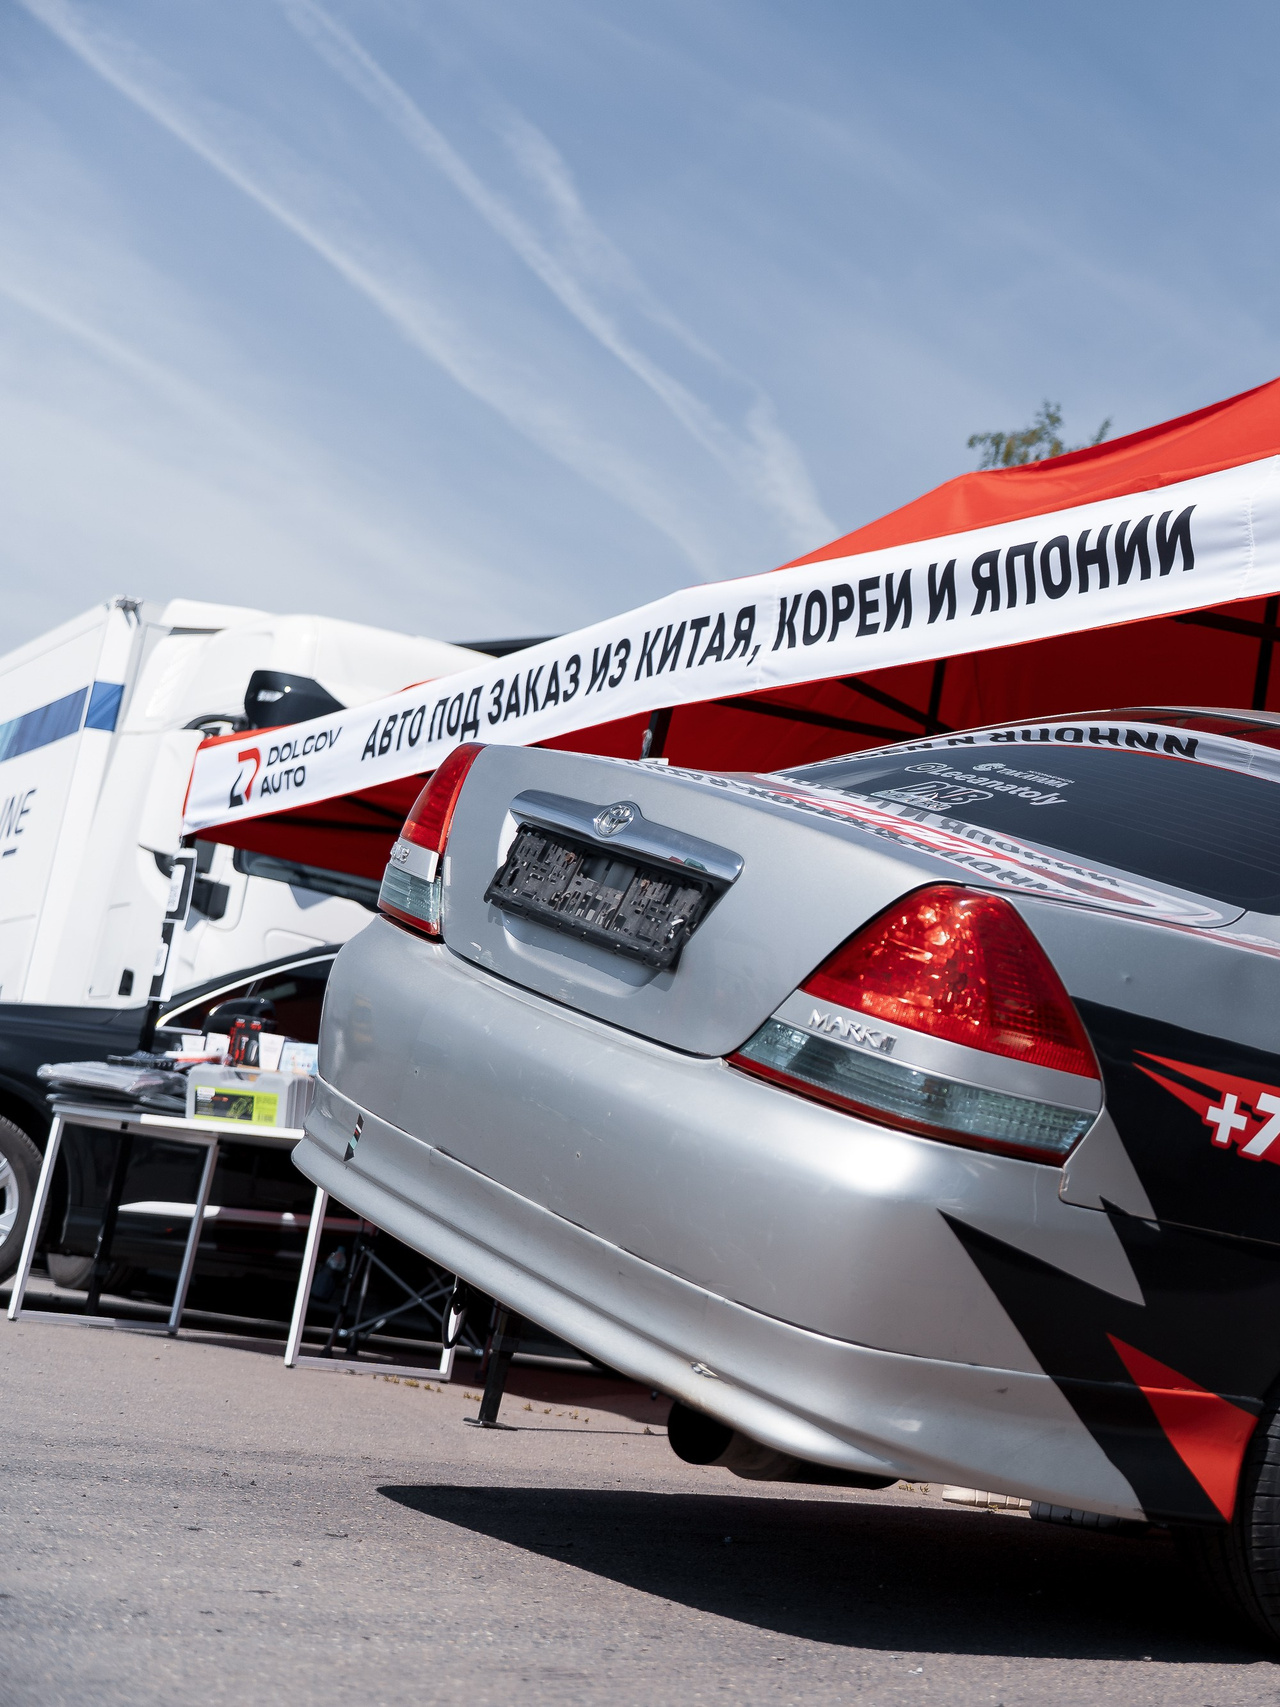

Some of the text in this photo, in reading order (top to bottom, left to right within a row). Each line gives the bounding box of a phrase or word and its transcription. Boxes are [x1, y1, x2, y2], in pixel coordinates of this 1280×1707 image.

[361, 505, 1197, 761] АВТО ПОД ЗАКАЗ ИЗ КИТАЯ, КОРЕИ И ЯПОНИИ
[267, 726, 343, 767] DOLGOV
[260, 766, 306, 797] AUTO
